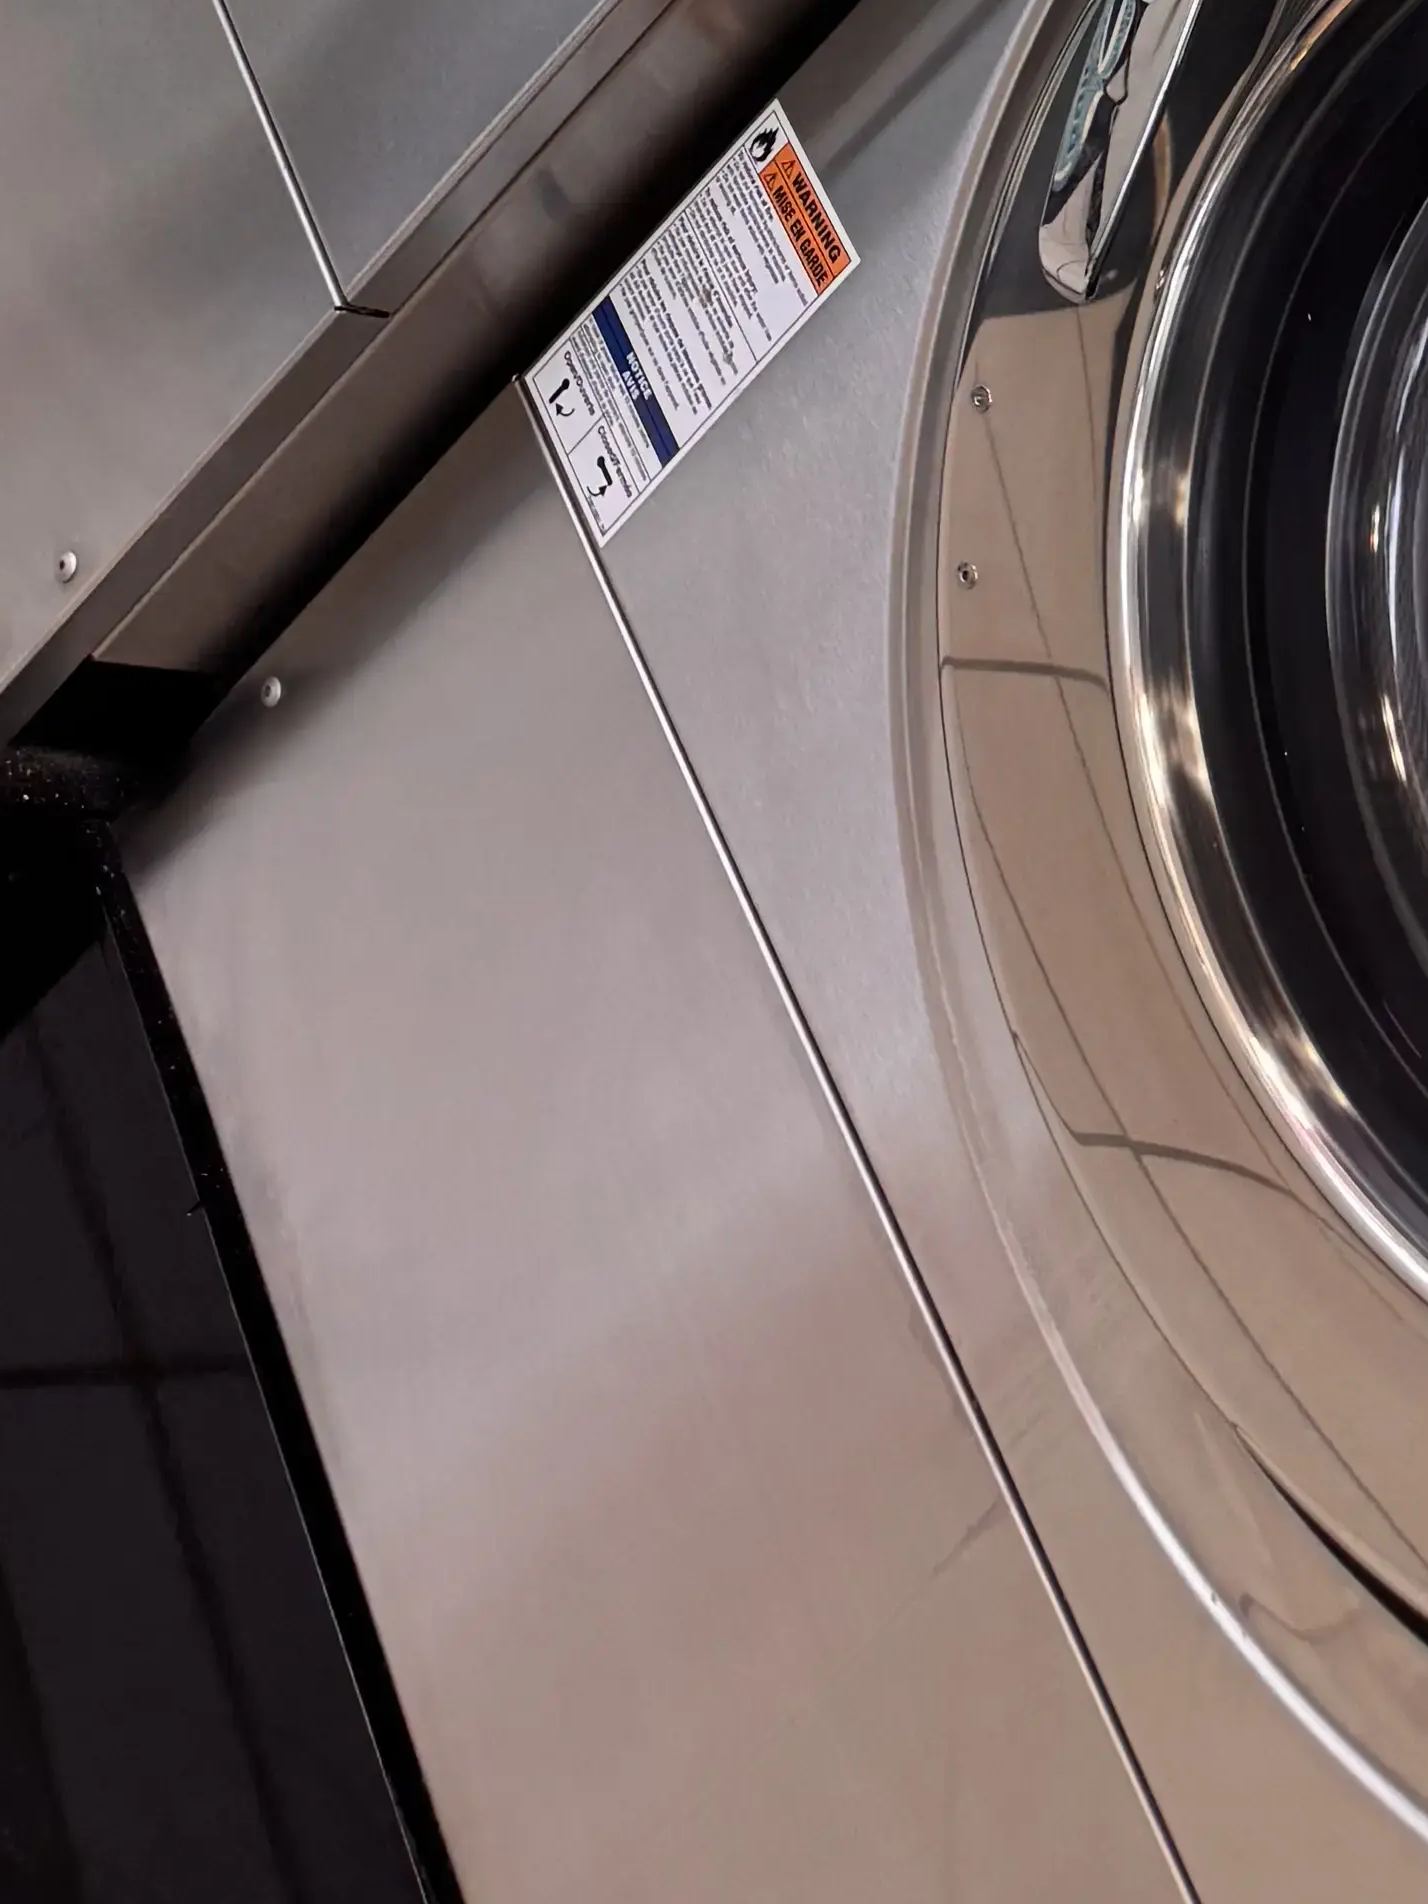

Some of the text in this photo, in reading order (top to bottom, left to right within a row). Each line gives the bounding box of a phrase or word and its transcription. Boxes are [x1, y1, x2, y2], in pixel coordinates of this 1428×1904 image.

[770, 185, 829, 287] MISE EN GARDE
[790, 174, 843, 263] WARNING
[621, 369, 640, 401] AVIS
[624, 351, 652, 400] NOTICE
